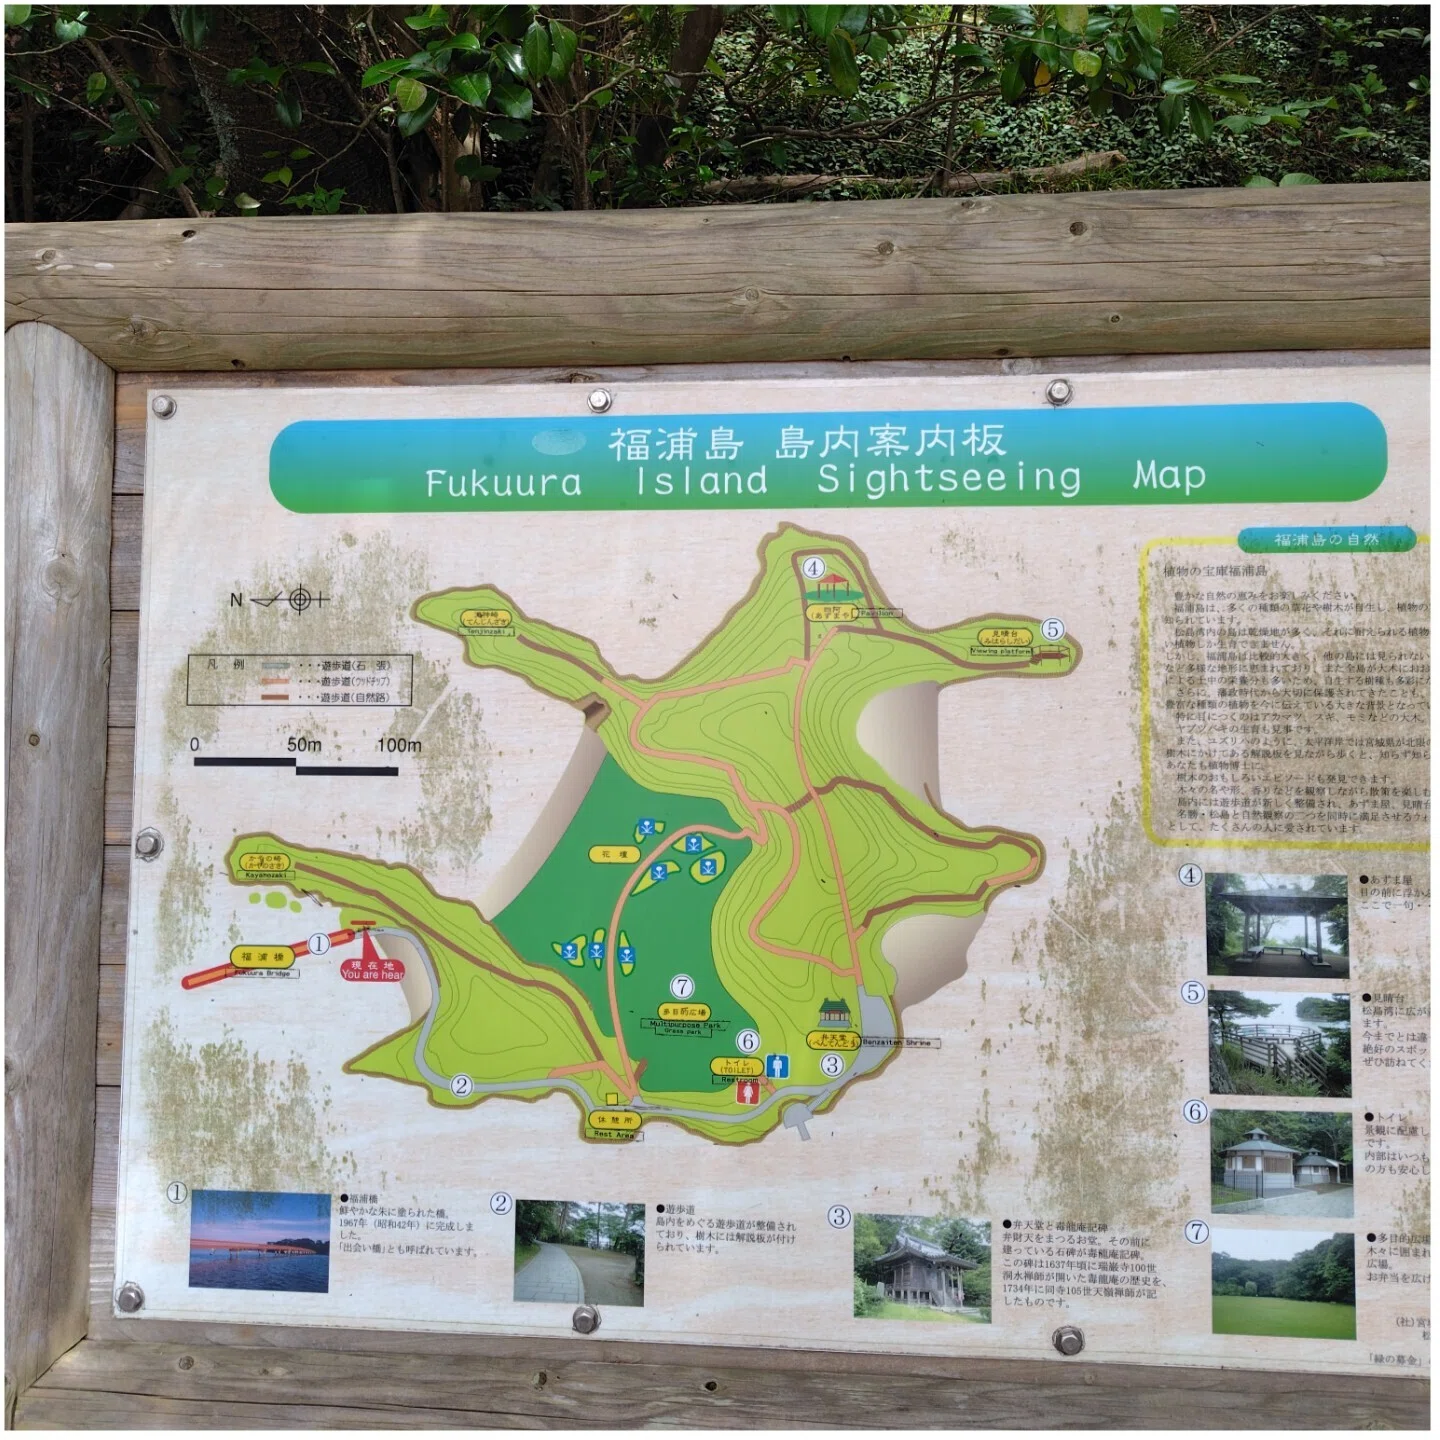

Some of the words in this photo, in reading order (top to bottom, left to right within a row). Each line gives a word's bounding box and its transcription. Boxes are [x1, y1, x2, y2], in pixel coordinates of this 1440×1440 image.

[608, 426, 744, 462] 福浦島
[775, 422, 1008, 460] 島内案内板
[426, 469, 582, 498] Fukuura
[637, 465, 768, 496] Island
[817, 460, 1081, 500] Sightseeing
[1133, 460, 1207, 496] Map
[1274, 533, 1379, 547] 福浦島の自然
[1163, 565, 1267, 578] 植物の宝庫福浦島
[230, 593, 242, 607] N
[189, 738, 200, 753] 0
[287, 738, 322, 753] 50m
[378, 738, 422, 753] 100m
[351, 961, 395, 971] 現在地
[342, 969, 361, 980] You
[363, 971, 379, 980] are
[349, 1193, 379, 1205] 福浦橋
[665, 1203, 696, 1216] 遊歩道
[656, 1216, 797, 1233] 島内をめぐる遊歩道が整備され
[339, 1230, 363, 1241] した。
[656, 1242, 721, 1255] られています。
[1003, 1296, 1071, 1309] したものです。
